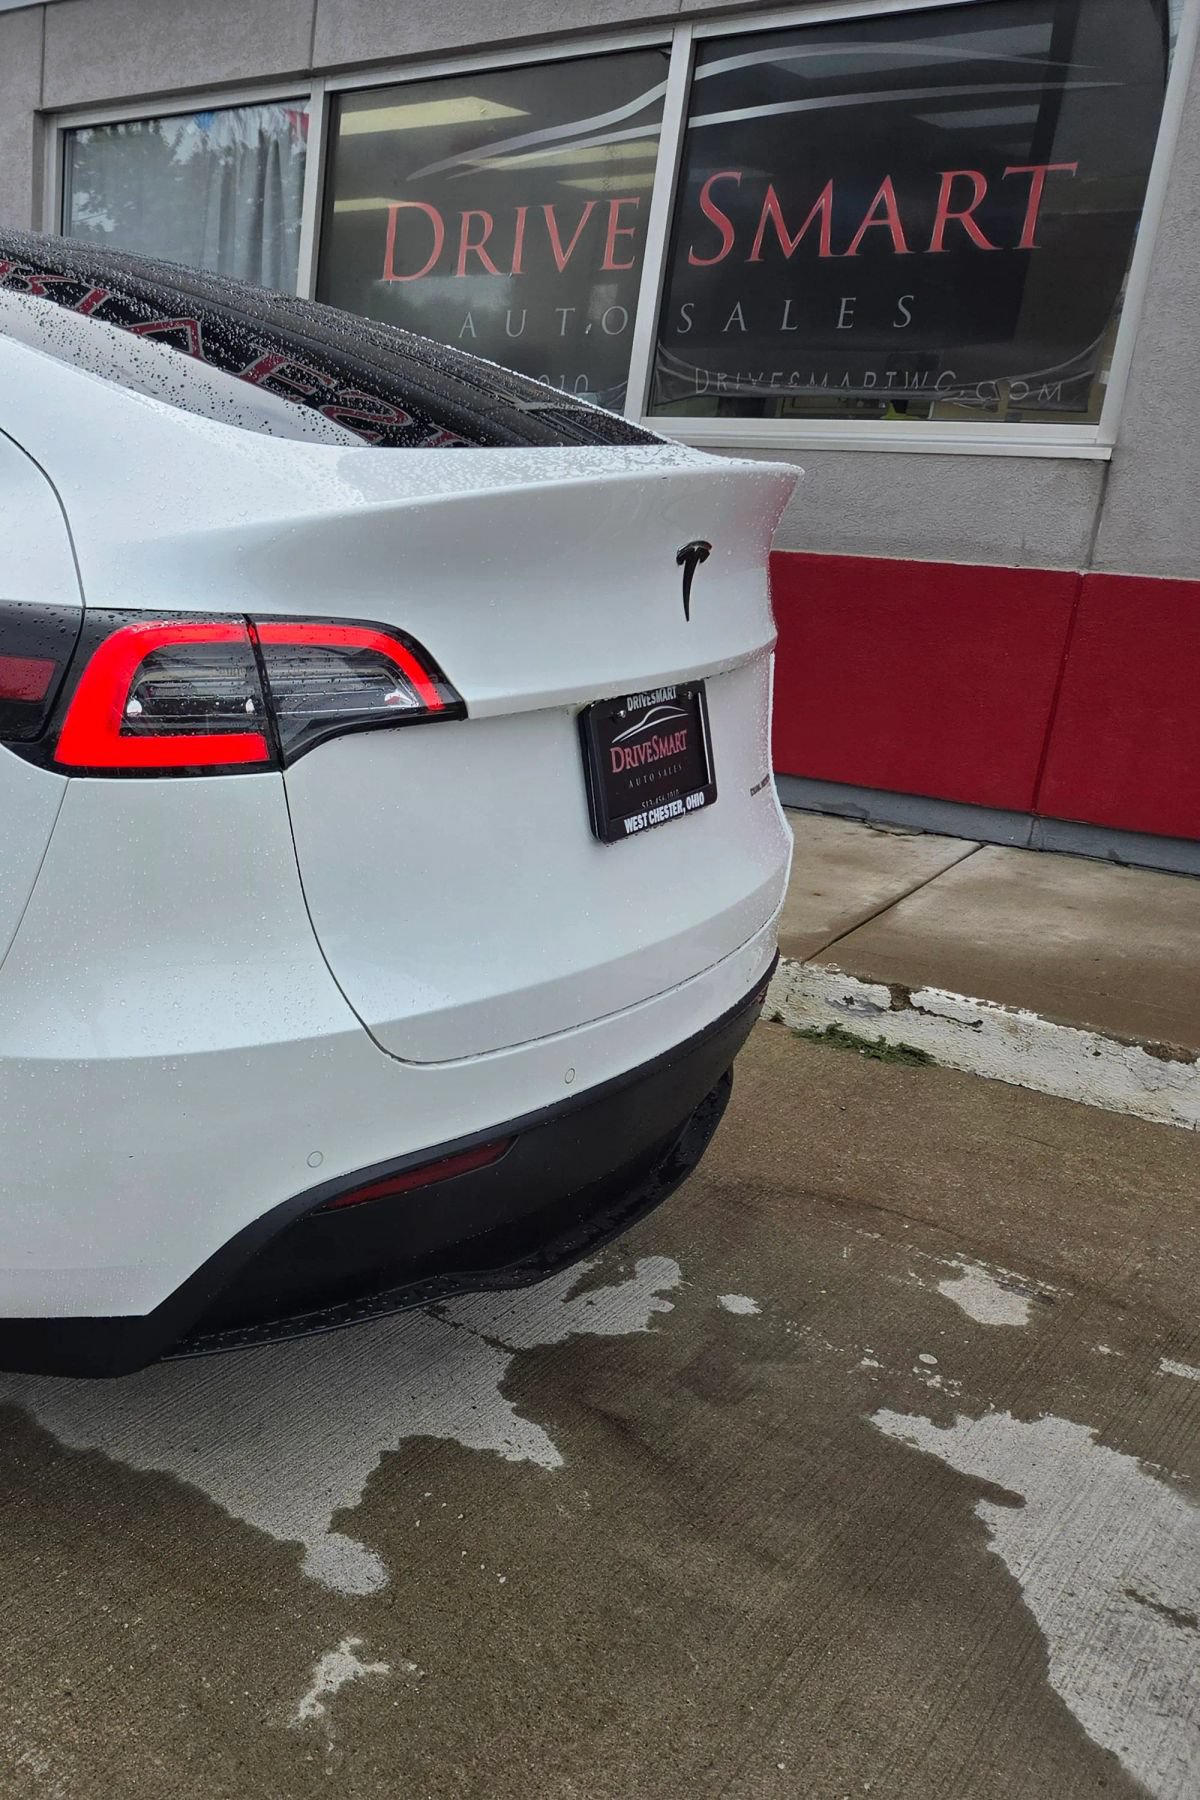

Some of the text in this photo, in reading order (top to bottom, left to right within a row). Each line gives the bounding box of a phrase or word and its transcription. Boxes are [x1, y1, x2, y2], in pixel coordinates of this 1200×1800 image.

[382, 161, 1079, 284] DRIVE SMART
[457, 294, 916, 339] AUTO SALES
[628, 763, 682, 788] AUTO SALES
[624, 791, 705, 834] WEST CHESTER, OHIO
